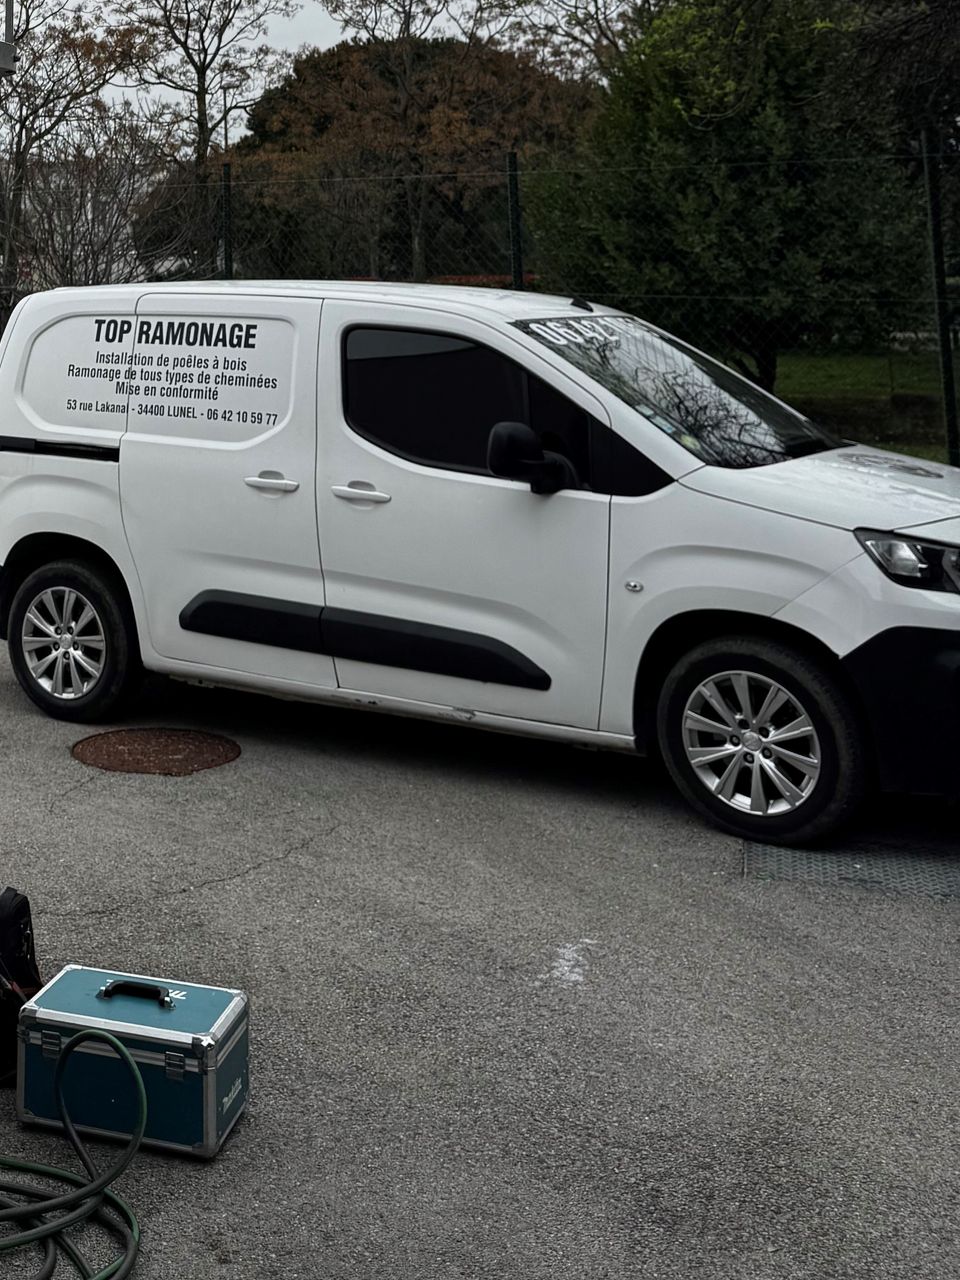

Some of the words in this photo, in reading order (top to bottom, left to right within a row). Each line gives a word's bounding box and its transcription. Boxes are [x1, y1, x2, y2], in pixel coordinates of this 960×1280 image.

[94, 319, 132, 343] TOP
[137, 320, 258, 349] RAMONAGE
[529, 321, 584, 345] 06
[568, 318, 620, 342] 42
[96, 351, 154, 366] Installation
[157, 354, 169, 367] de
[173, 354, 209, 370] poêles
[212, 356, 219, 369] à
[223, 357, 247, 371] bois
[67, 364, 121, 382] Ramonage
[124, 367, 137, 380] de
[140, 369, 162, 381] tous
[165, 370, 194, 385] types
[197, 371, 211, 384] de
[214, 373, 278, 389] cheminées
[115, 381, 141, 396] Mise
[144, 385, 157, 397] en
[160, 384, 219, 401] conformité
[67, 399, 77, 410] 53
[79, 401, 93, 411] rue
[95, 400, 129, 414] Lakanal
[137, 404, 165, 417] 34400
[167, 406, 197, 419] LUNEL
[207, 409, 218, 420] 06
[221, 410, 233, 422] 42
[236, 411, 248, 423] 10
[250, 412, 263, 424] 59
[266, 414, 278, 426] 77
